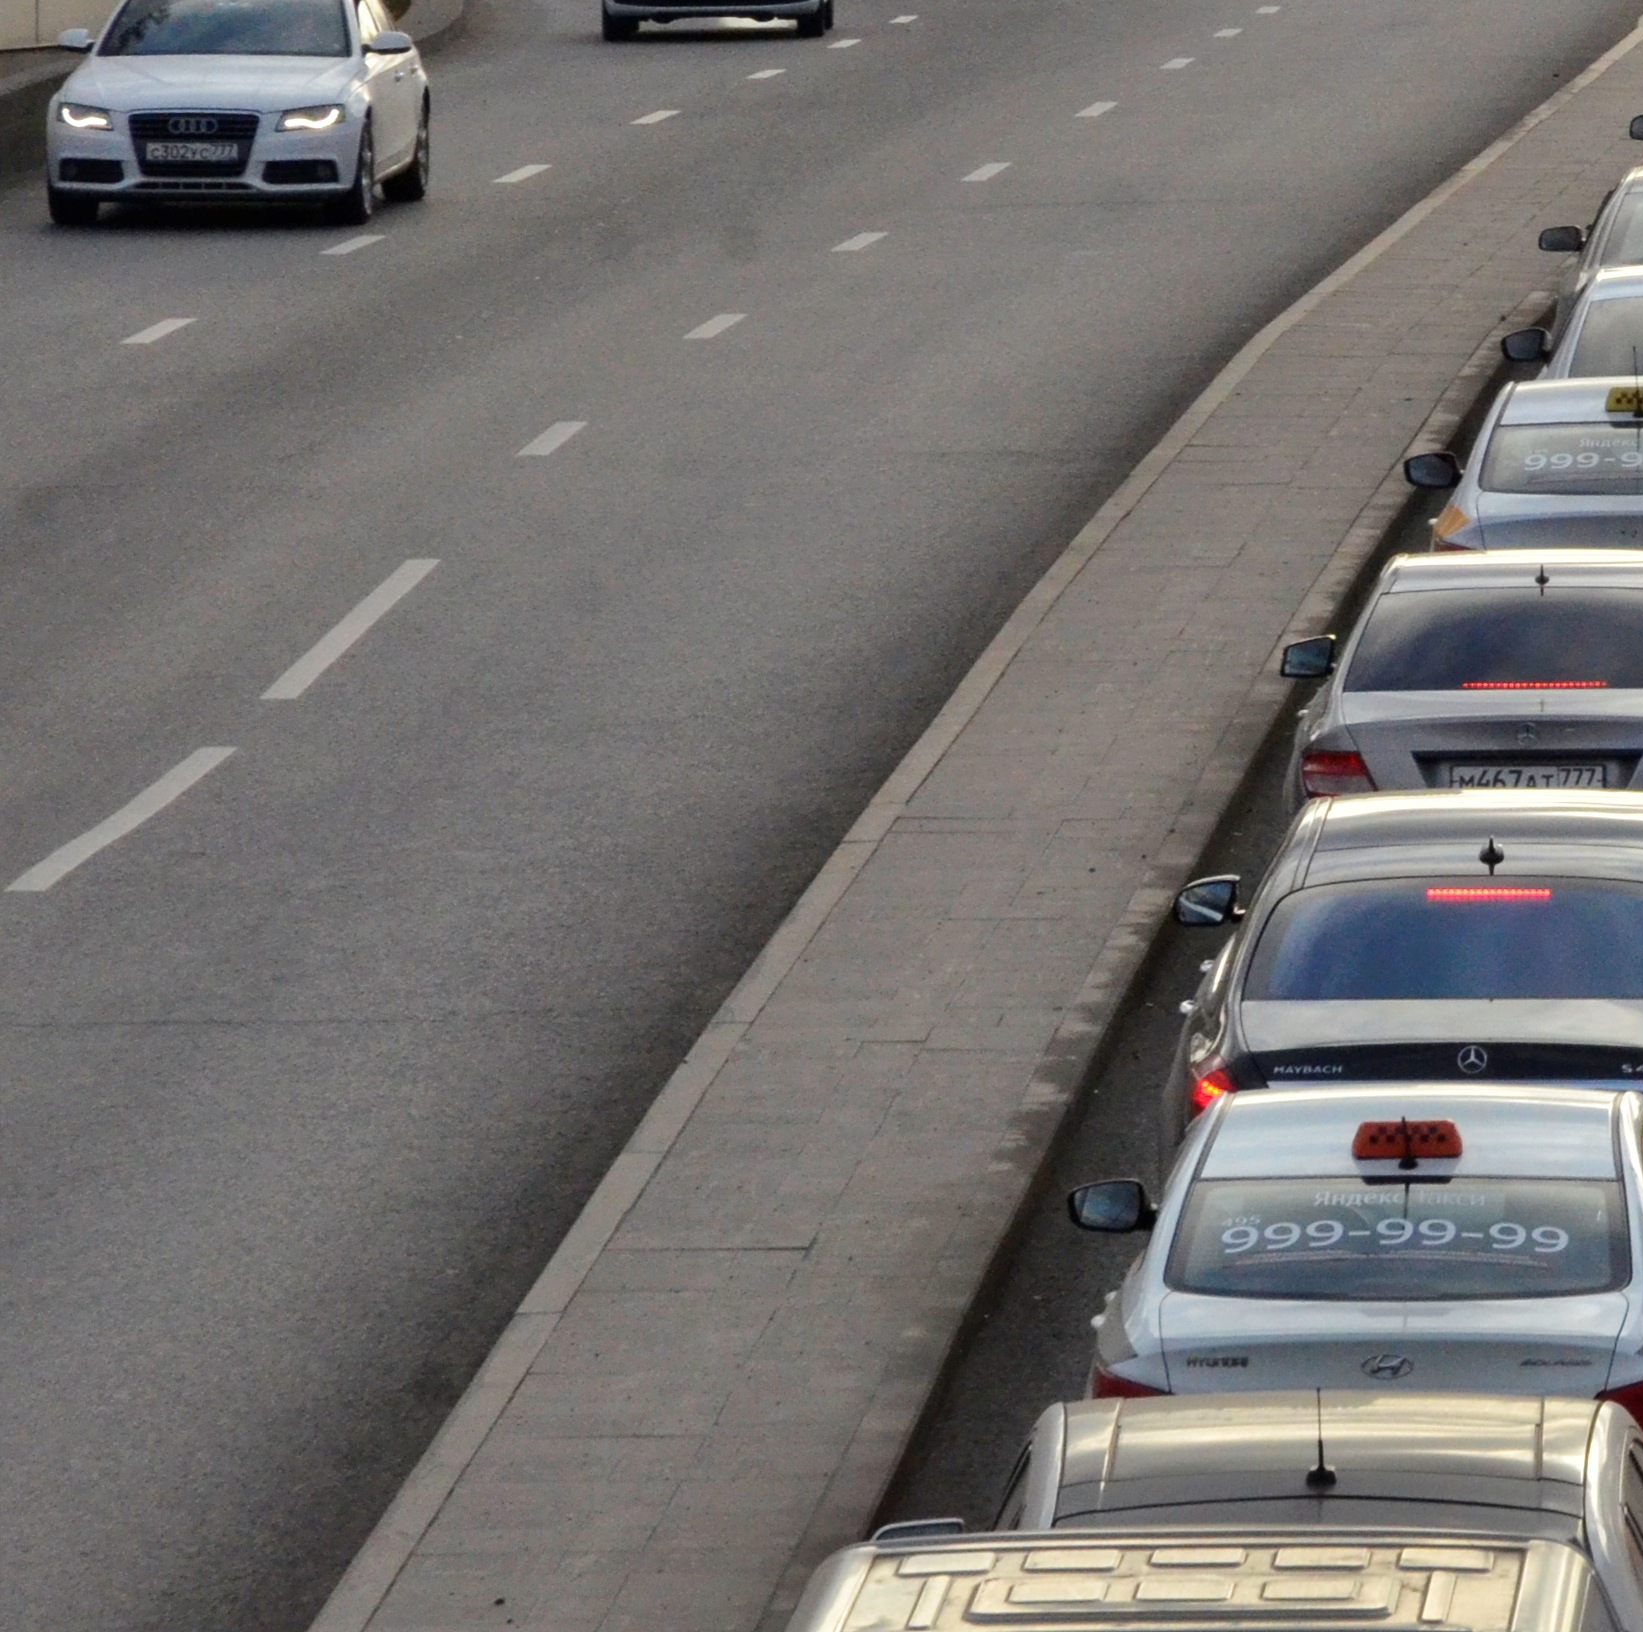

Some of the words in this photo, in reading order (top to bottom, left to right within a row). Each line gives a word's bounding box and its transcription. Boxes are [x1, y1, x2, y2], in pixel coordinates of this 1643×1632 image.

[1458, 769, 1555, 788] М467АТ
[1560, 768, 1596, 787] 777
[1273, 1063, 1342, 1074] MAYBACH
[1313, 1190, 1402, 1207] Яндекс
[1220, 1218, 1570, 1254] 999-99-99
